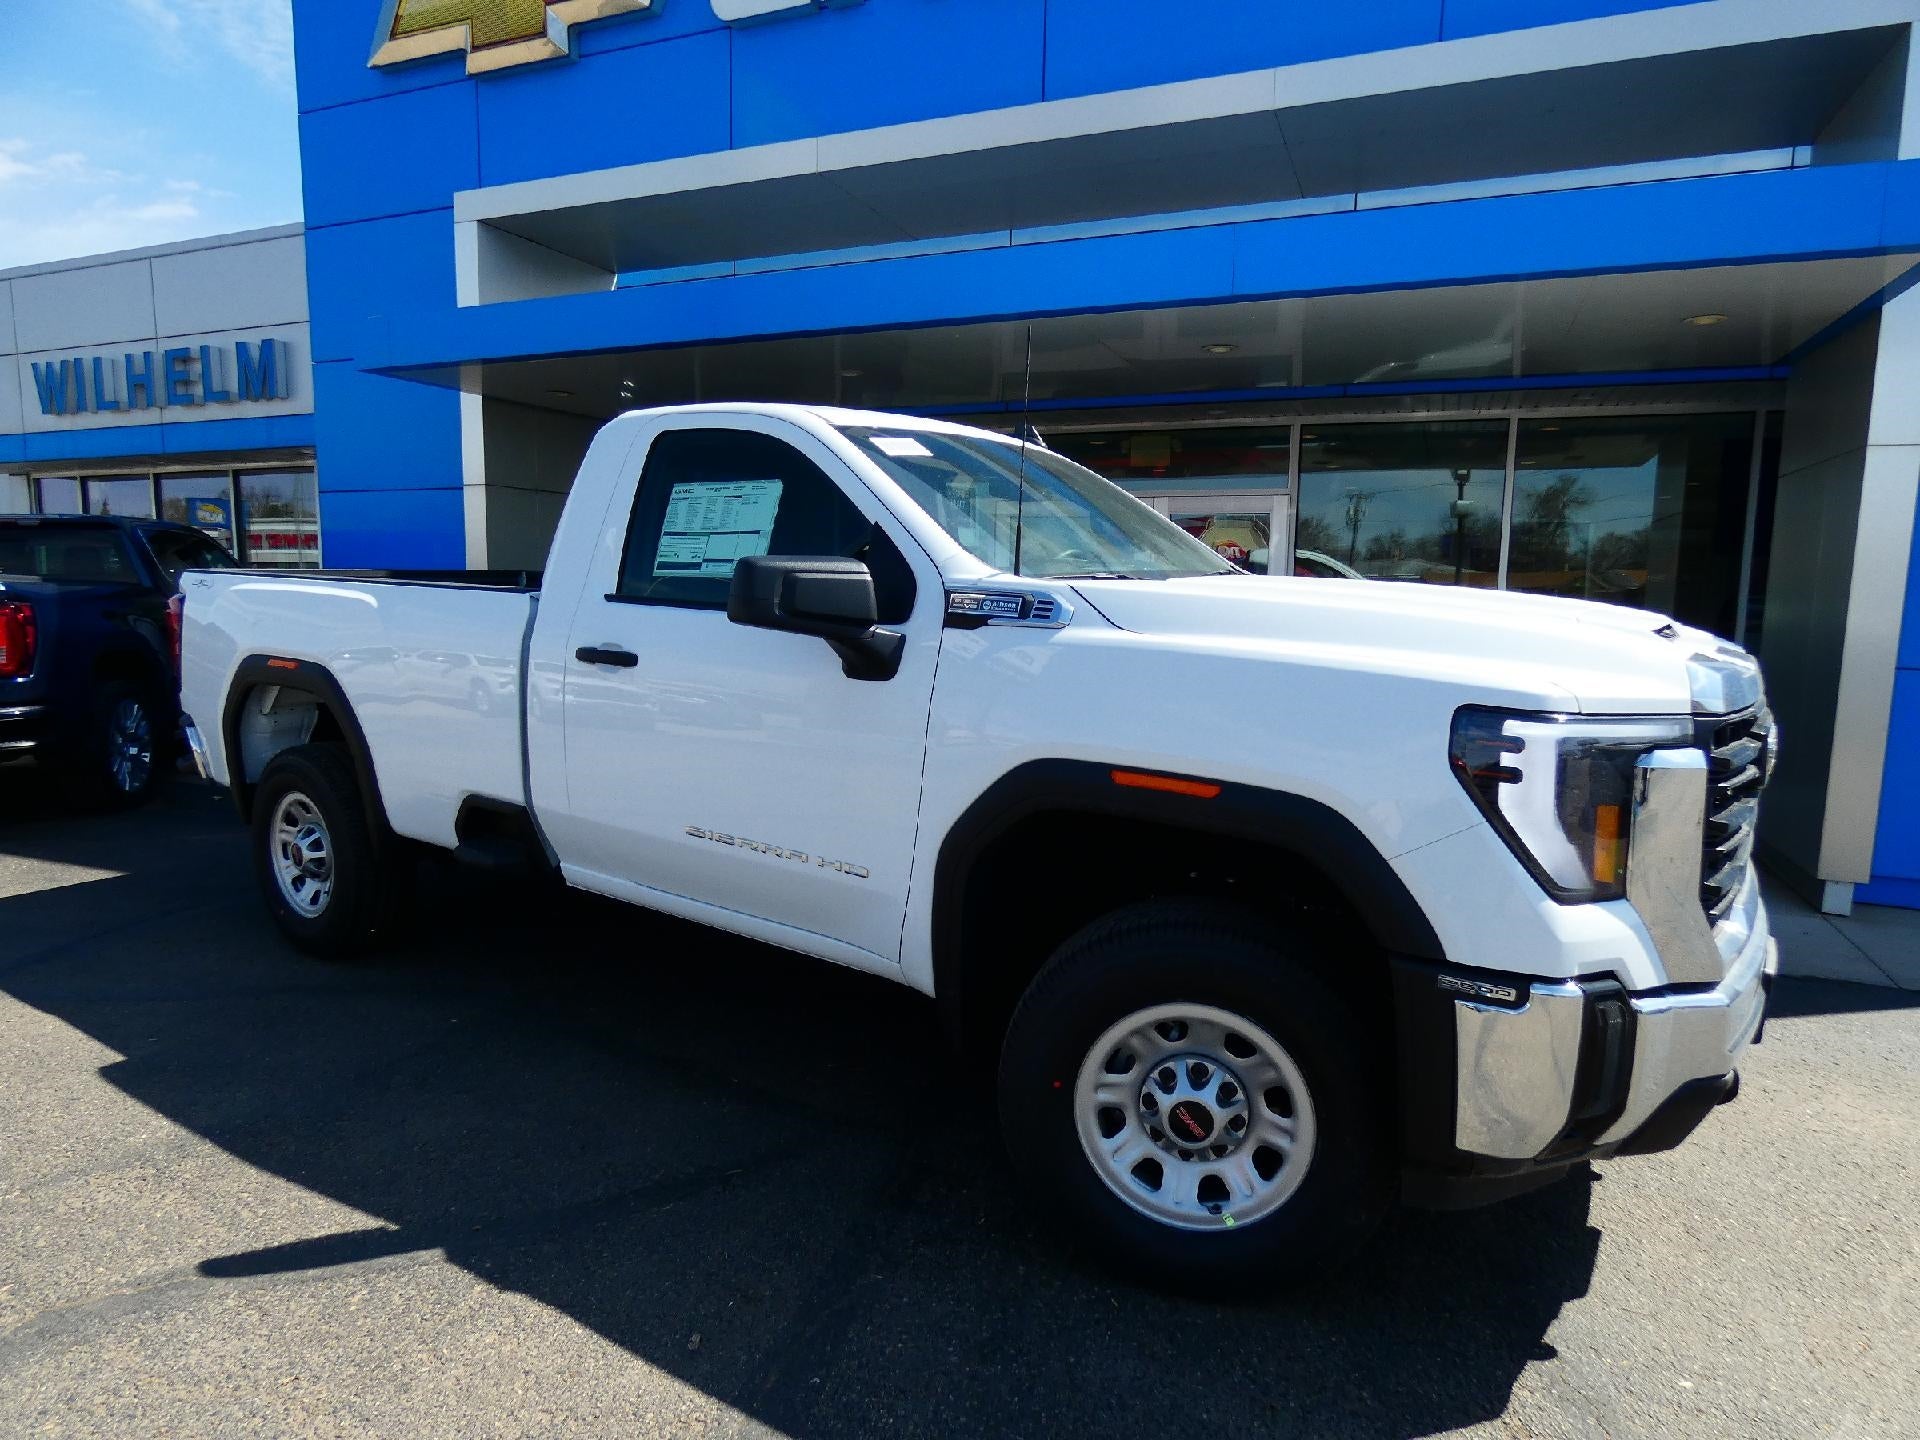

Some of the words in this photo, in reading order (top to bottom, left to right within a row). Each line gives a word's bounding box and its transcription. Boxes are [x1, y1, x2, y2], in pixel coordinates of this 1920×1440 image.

[31, 338, 287, 416] WILHELM
[684, 825, 809, 864] SIERRA
[816, 855, 870, 879] HD
